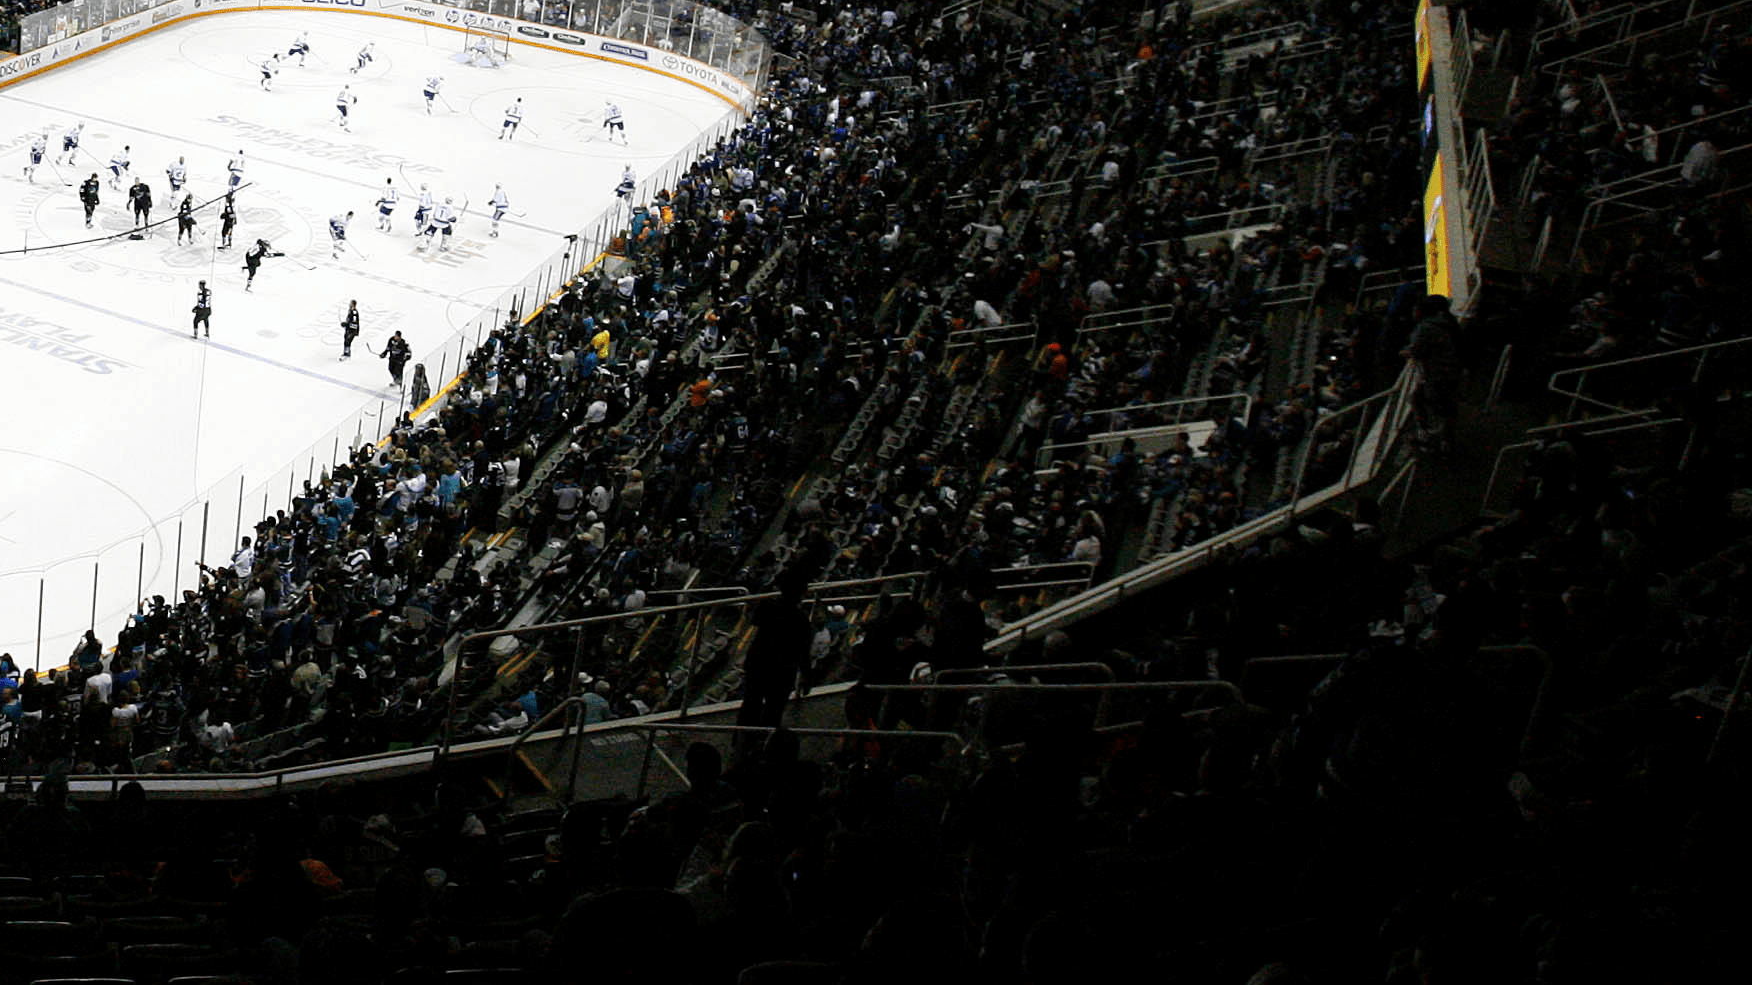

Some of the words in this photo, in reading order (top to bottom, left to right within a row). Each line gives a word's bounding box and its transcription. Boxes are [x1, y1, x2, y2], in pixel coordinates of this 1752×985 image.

[404, 4, 436, 17] verizon
[0, 55, 41, 78] DISCOVER
[679, 61, 718, 85] TOYOTA
